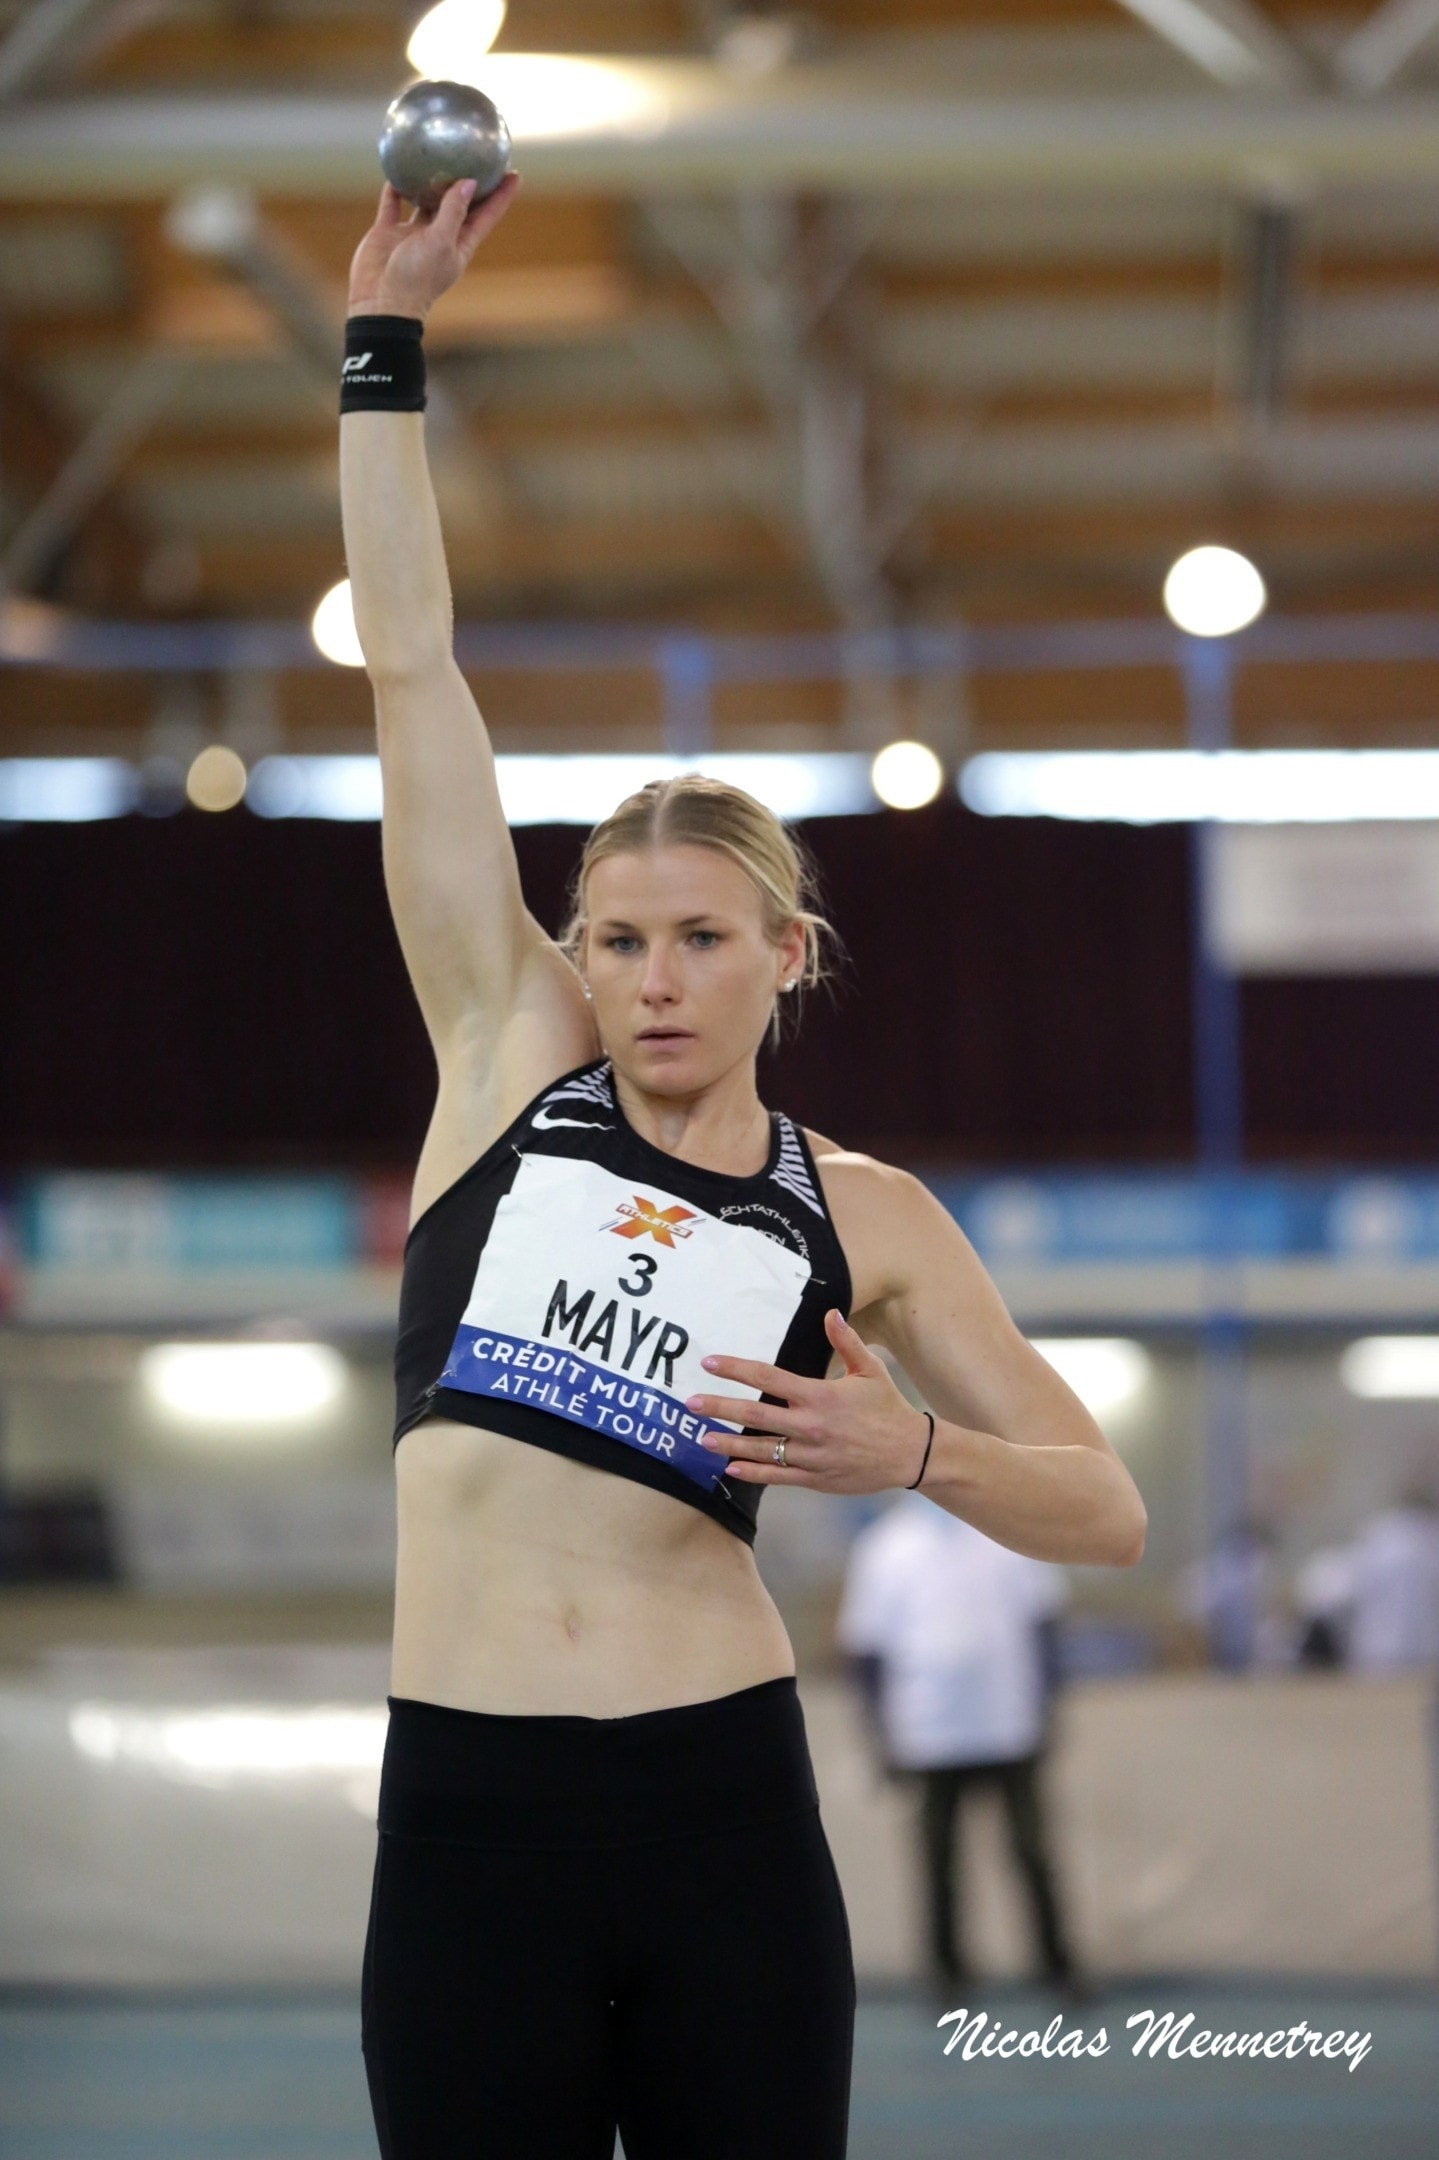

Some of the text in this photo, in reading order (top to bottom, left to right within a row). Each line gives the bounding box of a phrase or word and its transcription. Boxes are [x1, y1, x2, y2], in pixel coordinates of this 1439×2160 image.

[346, 374, 393, 383] TOUCH
[617, 1204, 691, 1237] ATHLETICS
[618, 1253, 658, 1297] 3
[541, 1279, 689, 1388] MAYR
[473, 1337, 586, 1384] CRÉDIT
[490, 1373, 676, 1457] ATHLÉ TOUR
